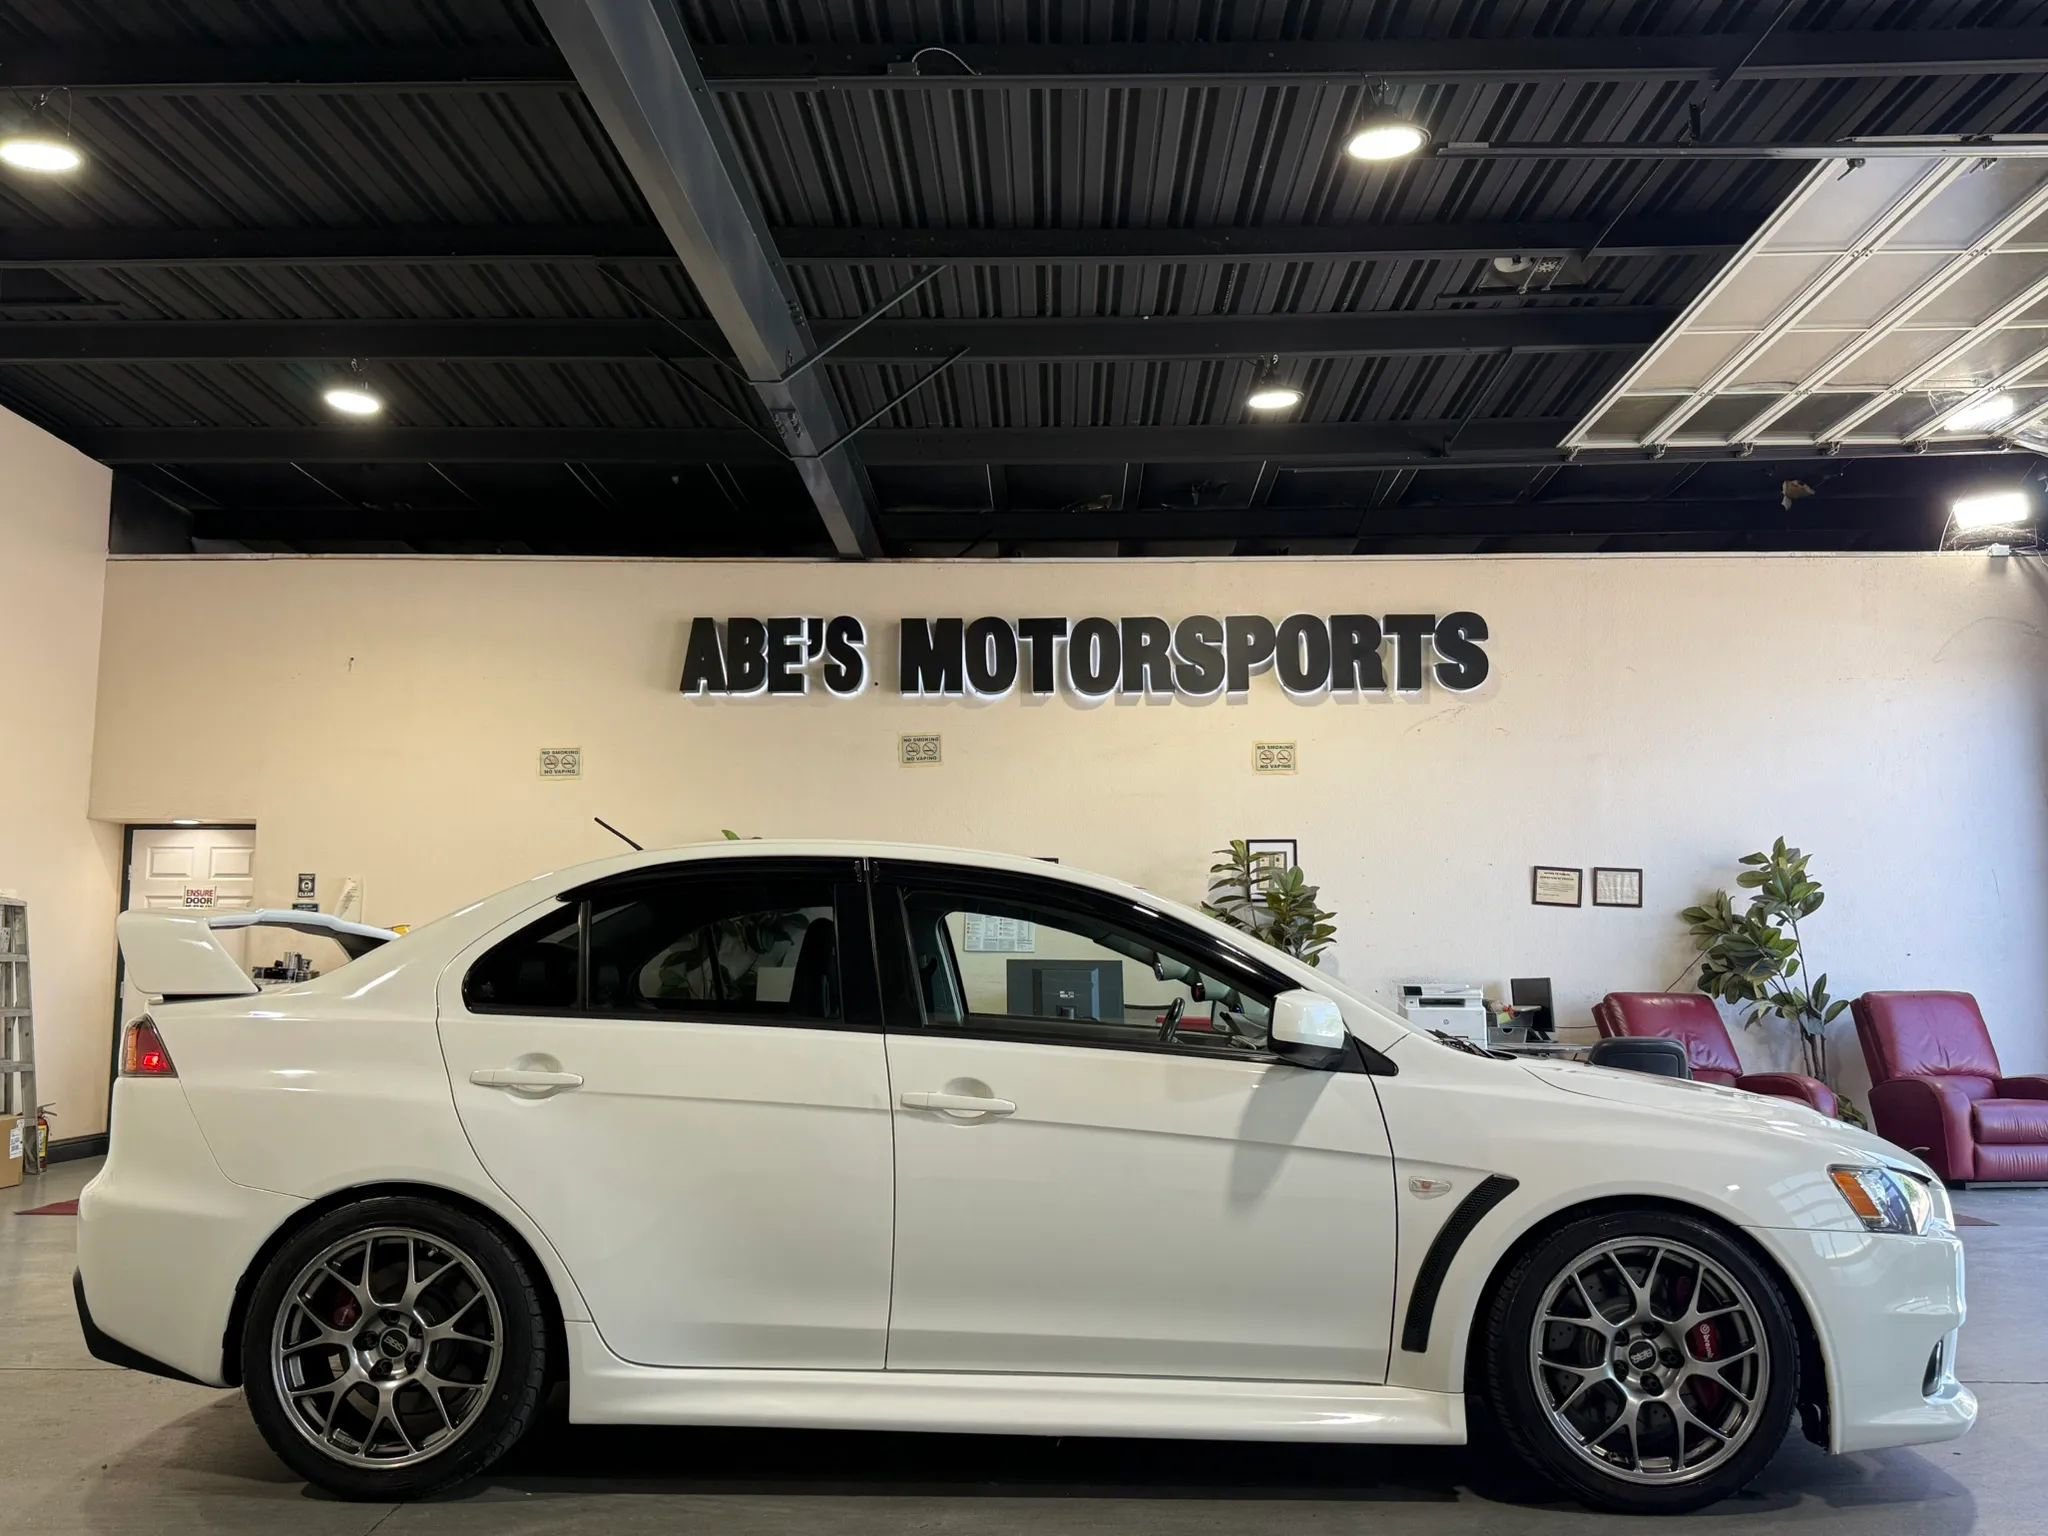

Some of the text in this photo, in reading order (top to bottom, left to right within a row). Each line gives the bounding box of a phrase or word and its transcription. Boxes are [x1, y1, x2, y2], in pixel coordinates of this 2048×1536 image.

[680, 612, 1489, 696] ABE'S MOTORSPORTS
[383, 1335, 405, 1352] BBS
[1630, 1348, 1653, 1364] BBS
